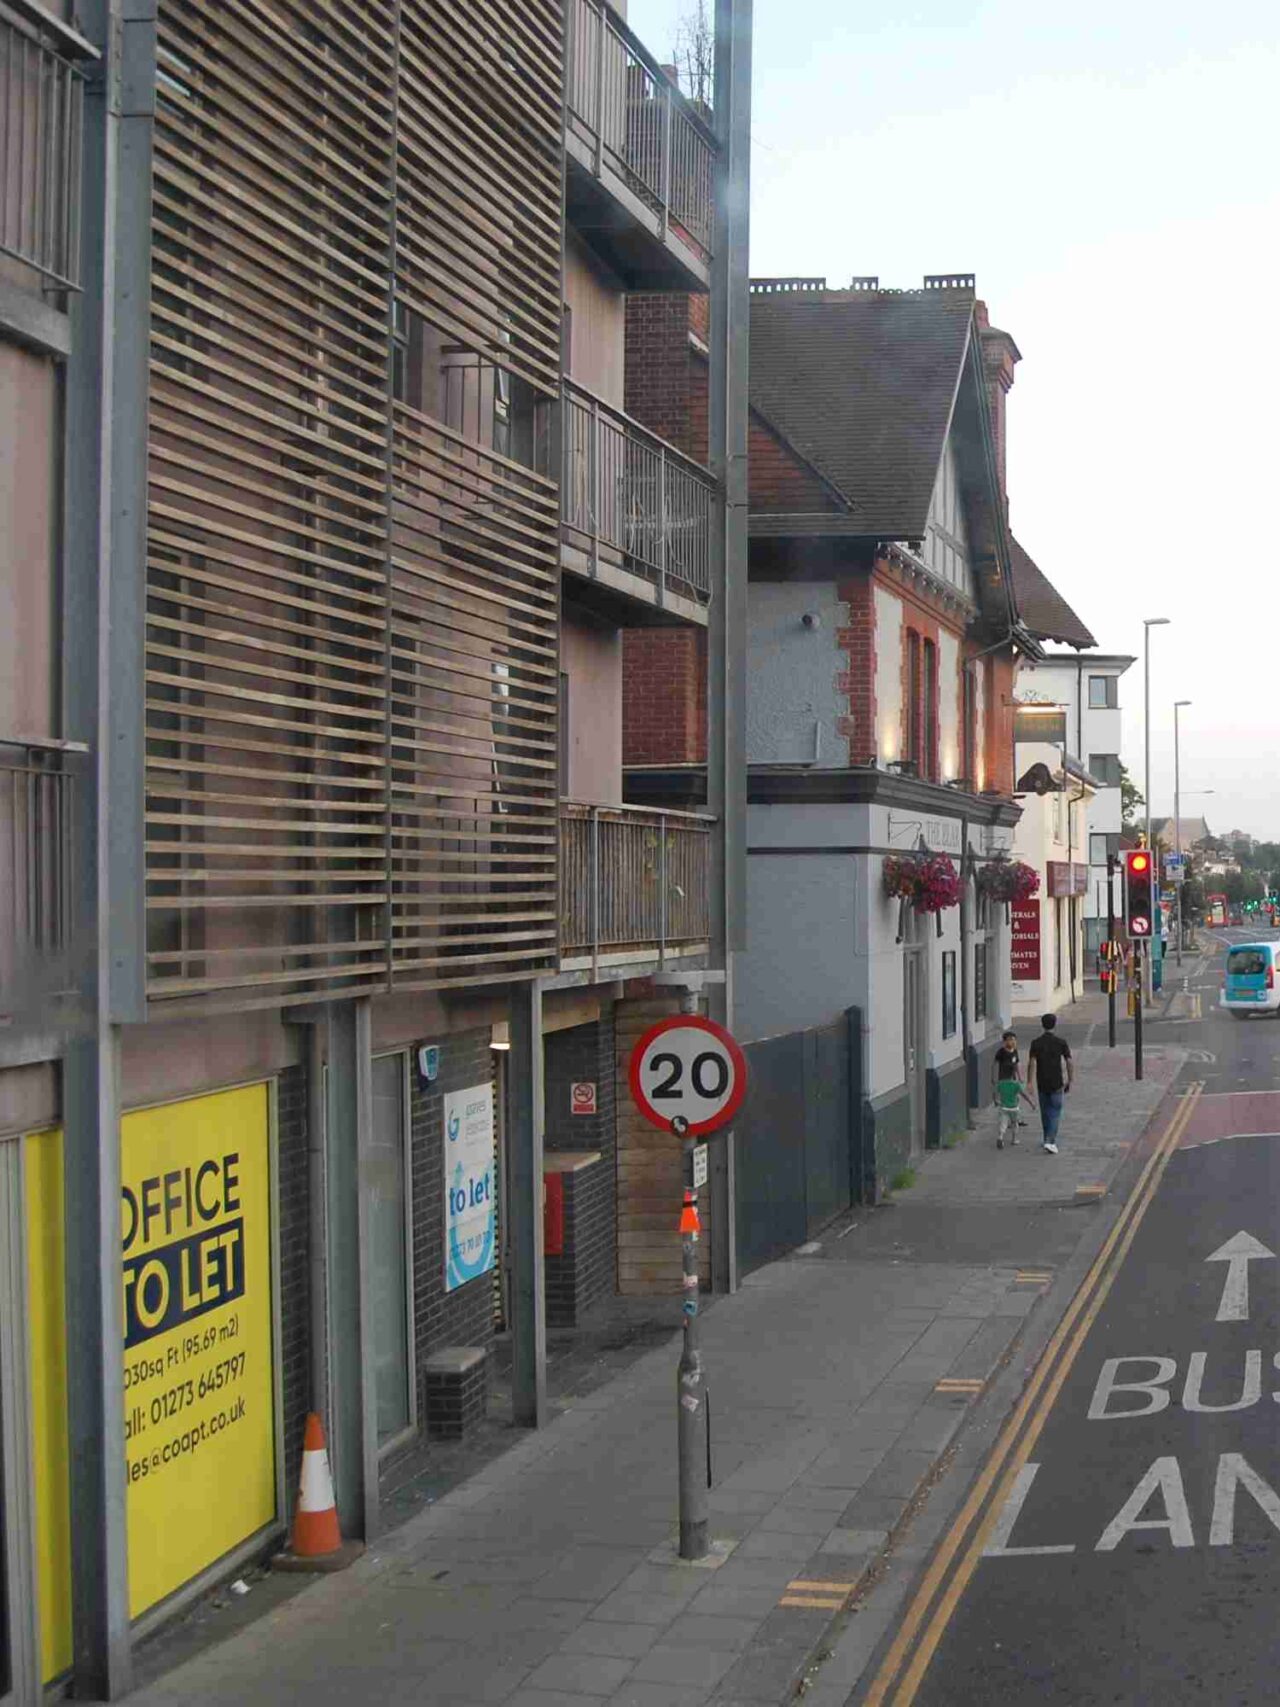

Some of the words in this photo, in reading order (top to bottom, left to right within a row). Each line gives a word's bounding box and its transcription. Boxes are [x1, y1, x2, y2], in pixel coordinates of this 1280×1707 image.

[649, 1052, 729, 1099] 20
[450, 1187, 465, 1216] to
[470, 1172, 489, 1207] let
[122, 1259, 170, 1339] TO
[181, 1228, 240, 1312] LET
[167, 1347, 179, 1369] Ft
[183, 1327, 217, 1363] (95.69
[219, 1313, 239, 1342] m2)
[150, 1380, 194, 1425] 01273
[198, 1352, 246, 1399] 645797
